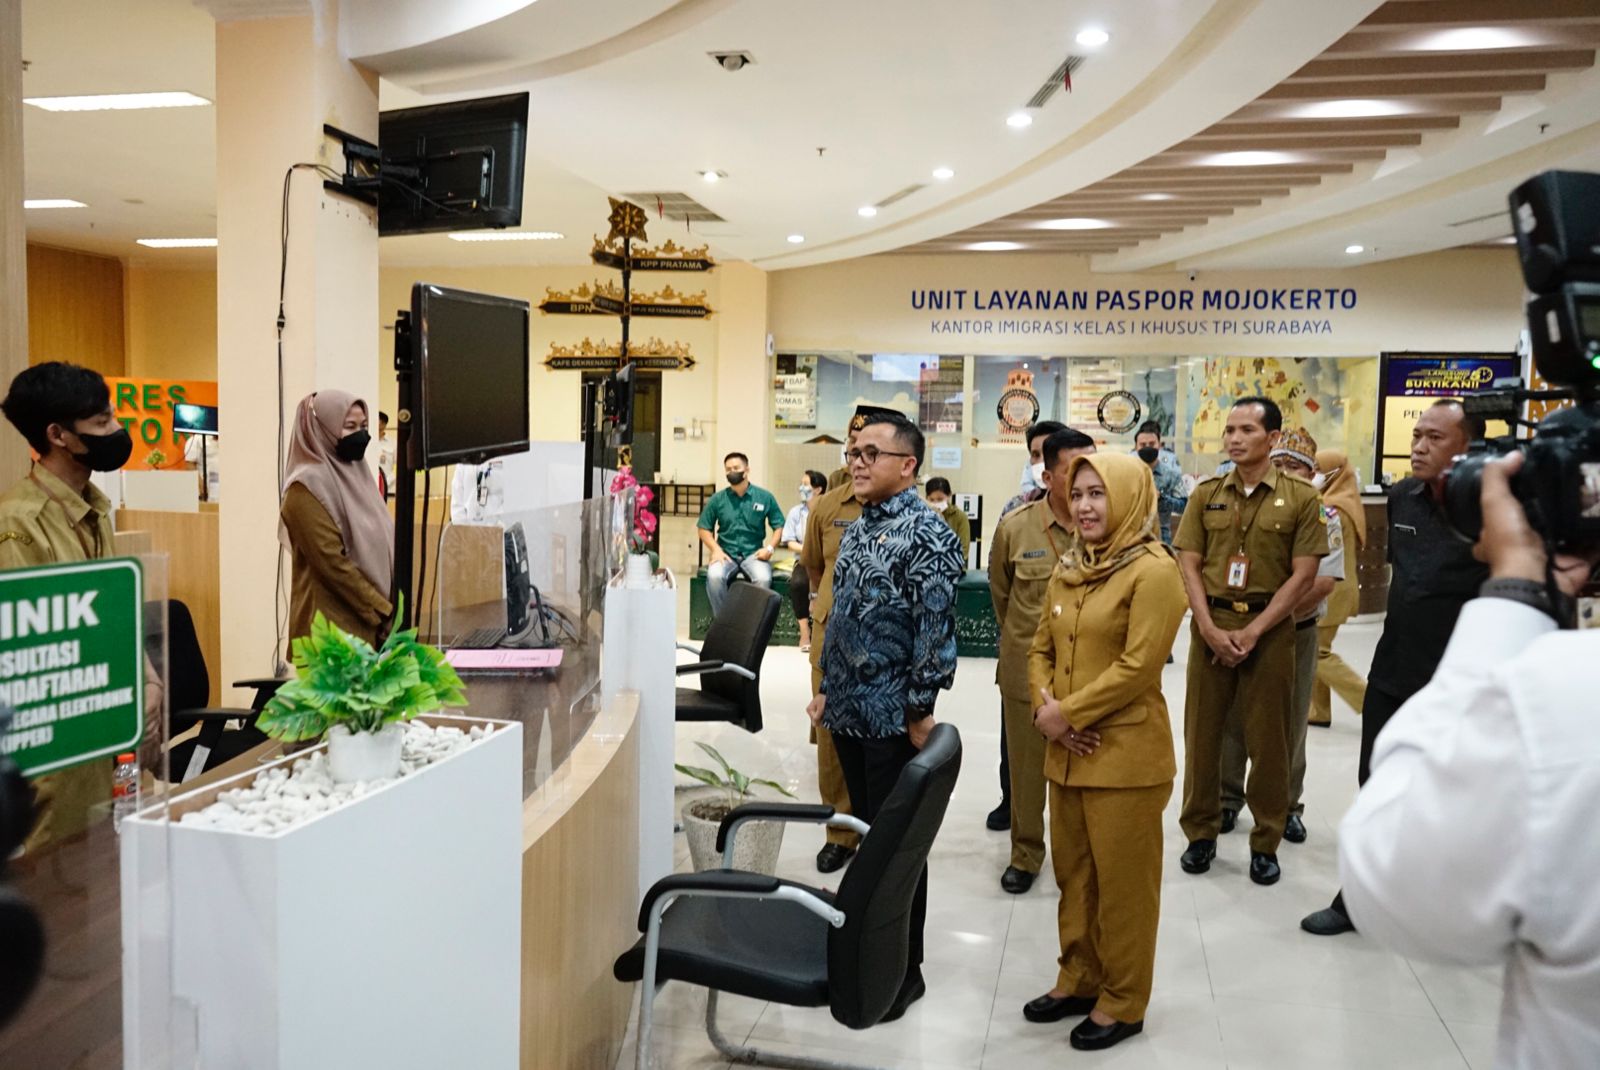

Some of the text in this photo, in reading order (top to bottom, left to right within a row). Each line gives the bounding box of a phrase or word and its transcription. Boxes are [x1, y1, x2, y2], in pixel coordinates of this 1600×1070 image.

[660, 261, 702, 269] PRATAMA
[570, 303, 593, 313] BPN
[911, 288, 1357, 310] UNIT LAYANAN PASPOR MOJOKERTO
[931, 320, 1332, 335] KANTOR IMIGRASI KELAS I KHUSUS TPI SURABAYA
[116, 383, 187, 411] RES
[0, 590, 100, 641] INIK
[7, 704, 58, 731] ECARA
